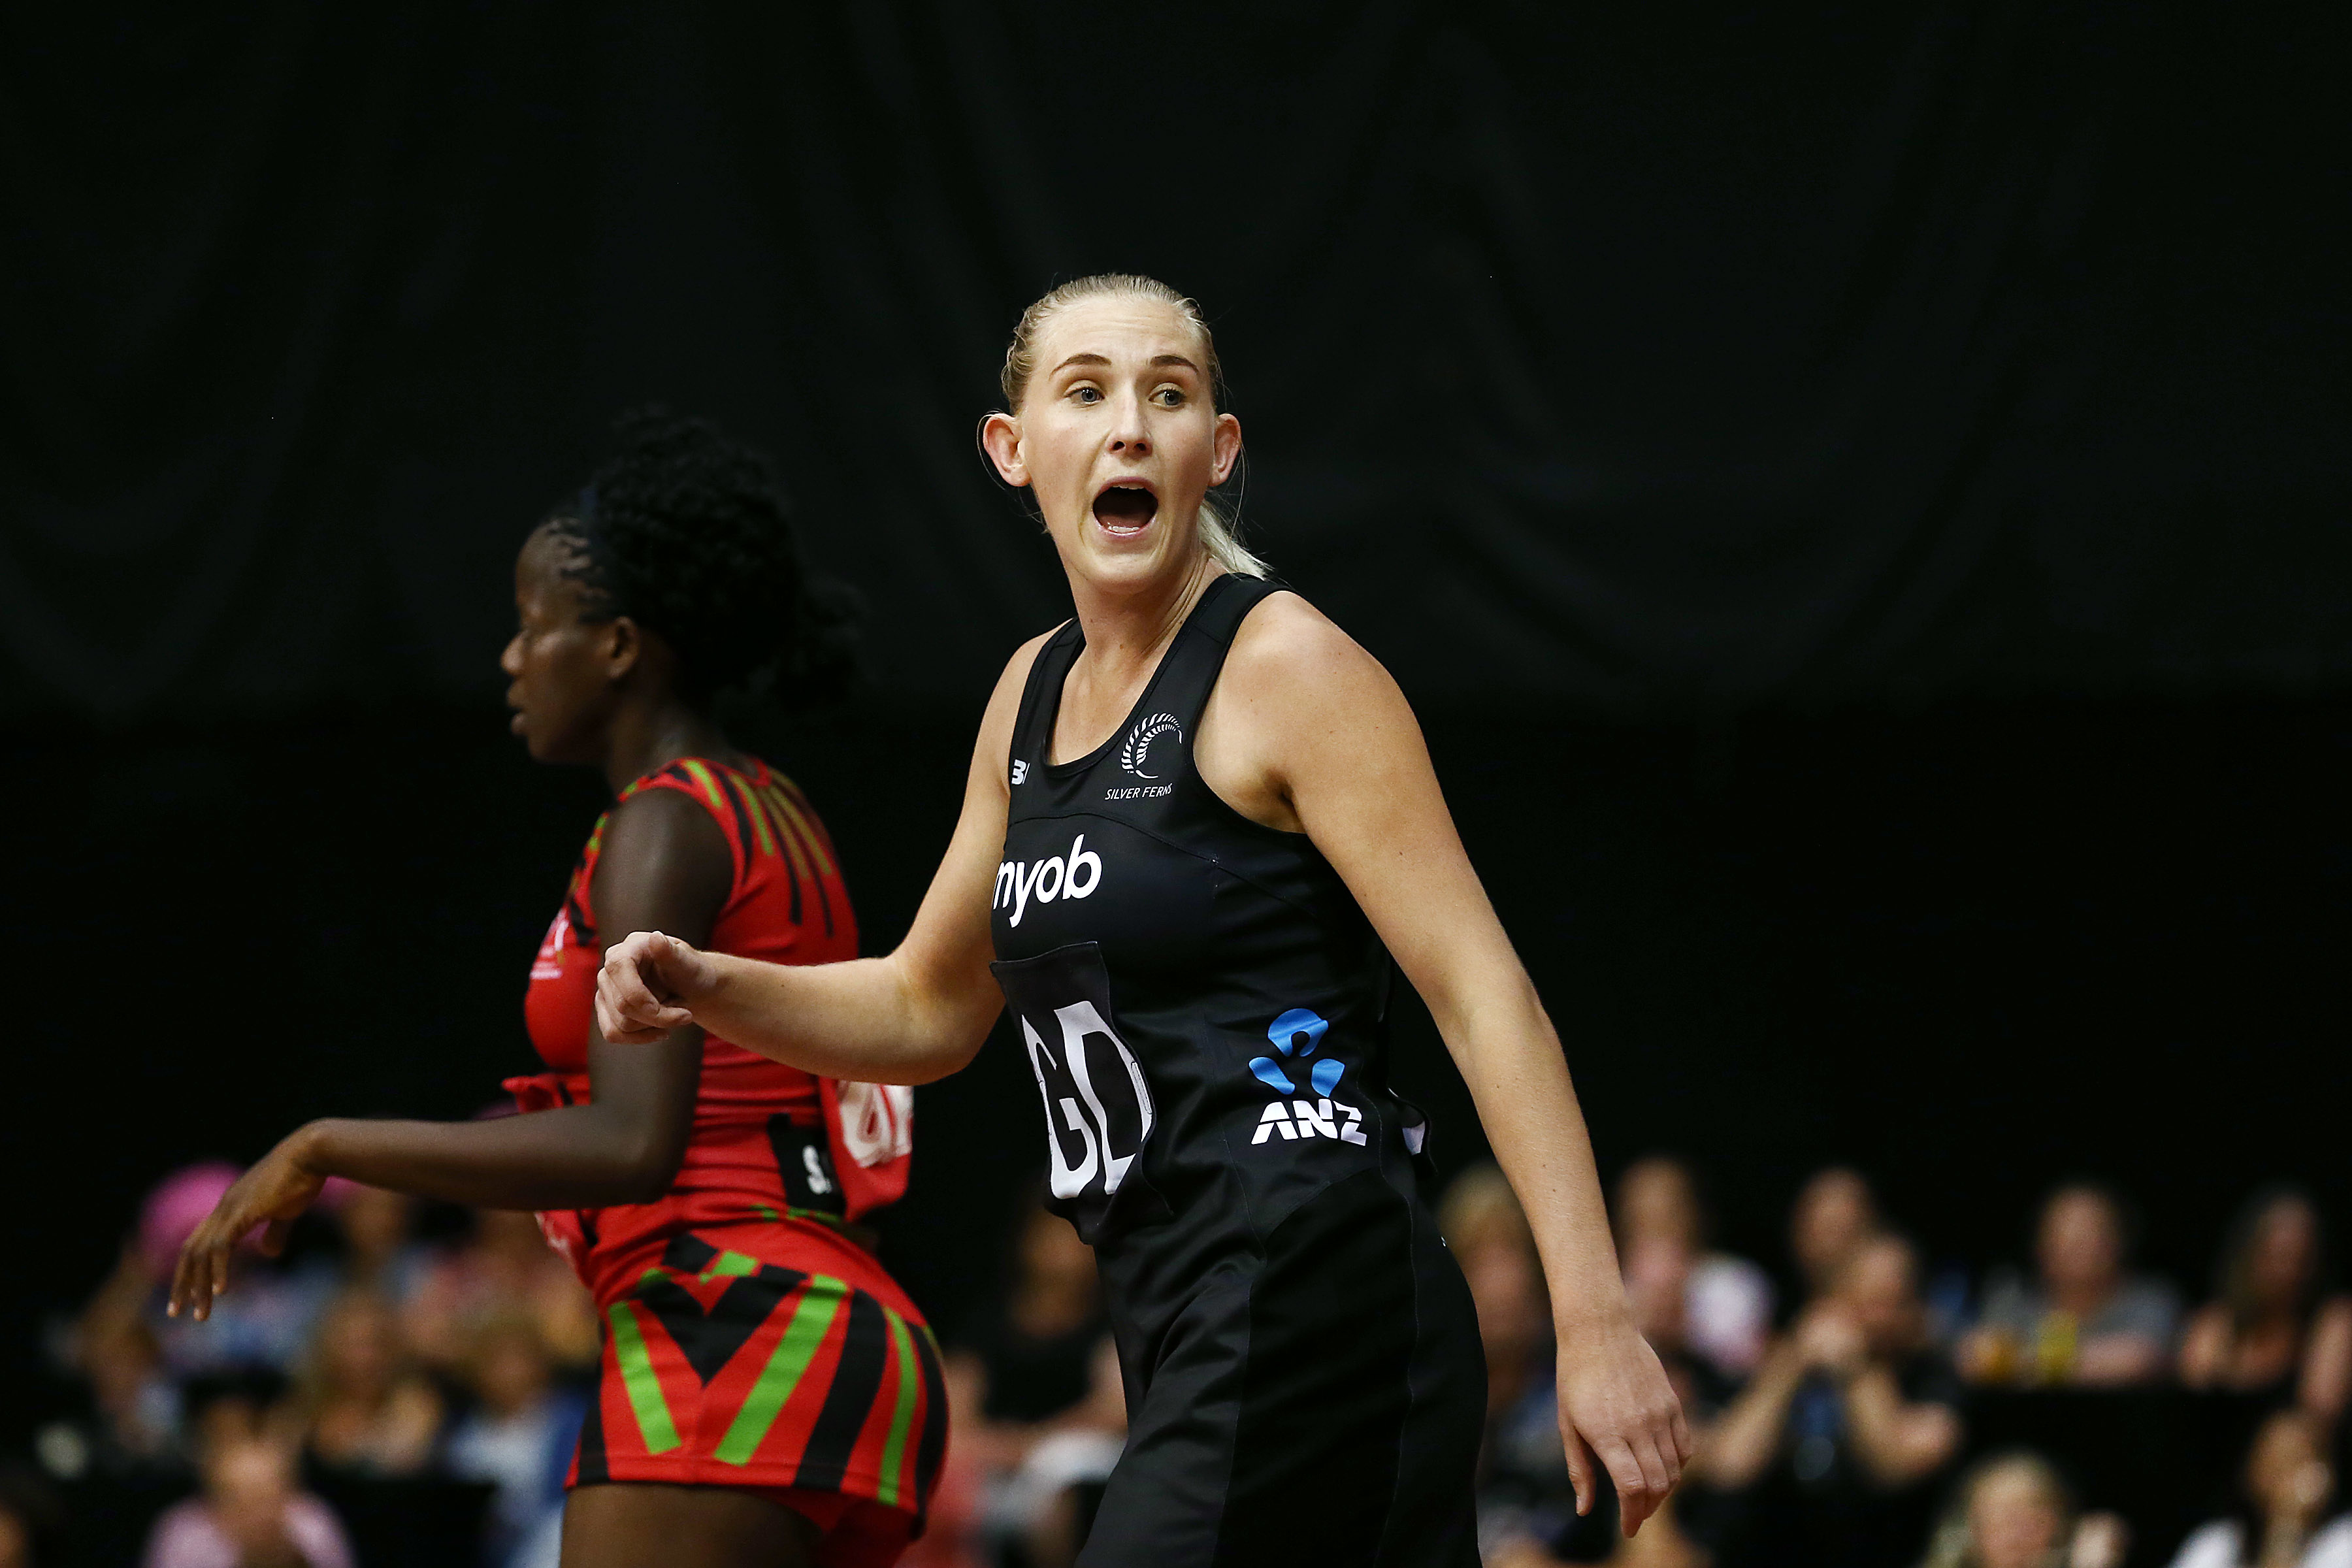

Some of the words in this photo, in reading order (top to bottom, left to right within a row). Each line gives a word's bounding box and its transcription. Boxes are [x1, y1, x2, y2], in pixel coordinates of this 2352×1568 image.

[1104, 788, 1141, 800] SILVER
[1141, 783, 1173, 798] FERNS
[1021, 1000, 1153, 1200] GD
[1250, 1098, 1367, 1147] ANZ
